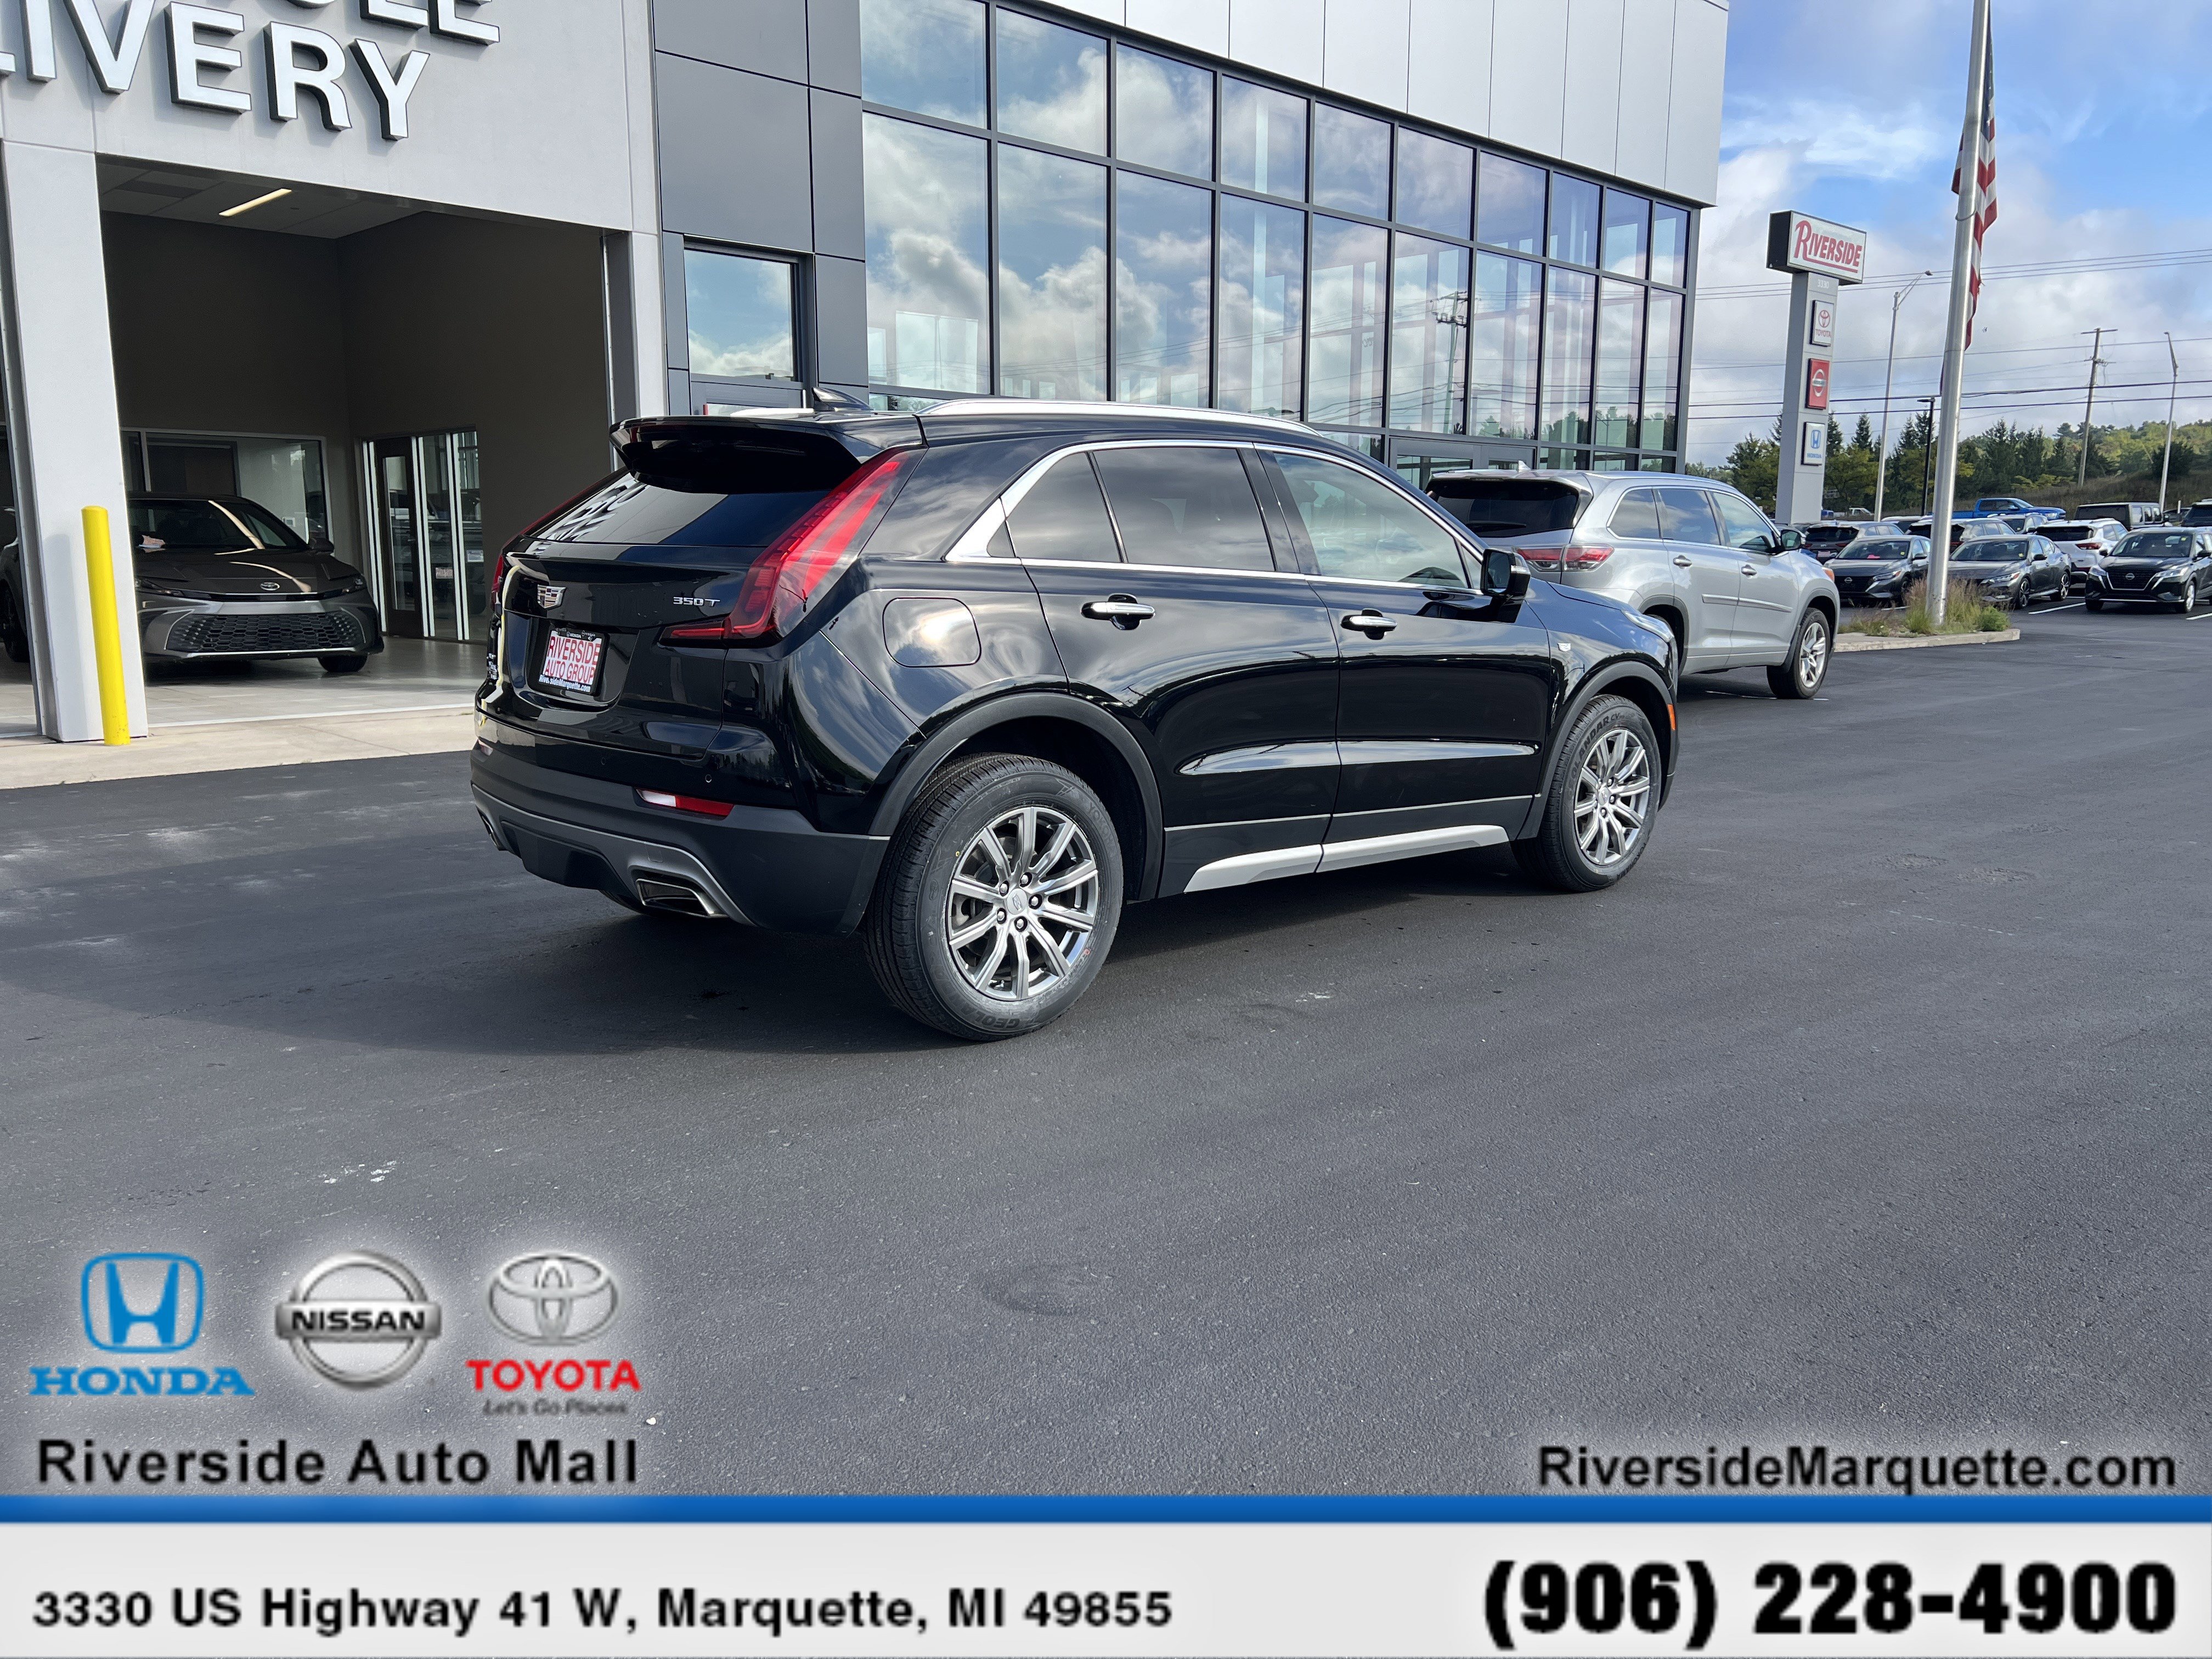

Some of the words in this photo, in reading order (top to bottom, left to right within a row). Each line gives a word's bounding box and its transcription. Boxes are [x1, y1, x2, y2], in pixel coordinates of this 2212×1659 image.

[0, 0, 430, 141] IVERY
[1815, 329, 1831, 338] TOYOTA
[548, 636, 601, 665] RIVERSIDE
[544, 659, 566, 678] AUTO
[567, 662, 596, 684] GROUP
